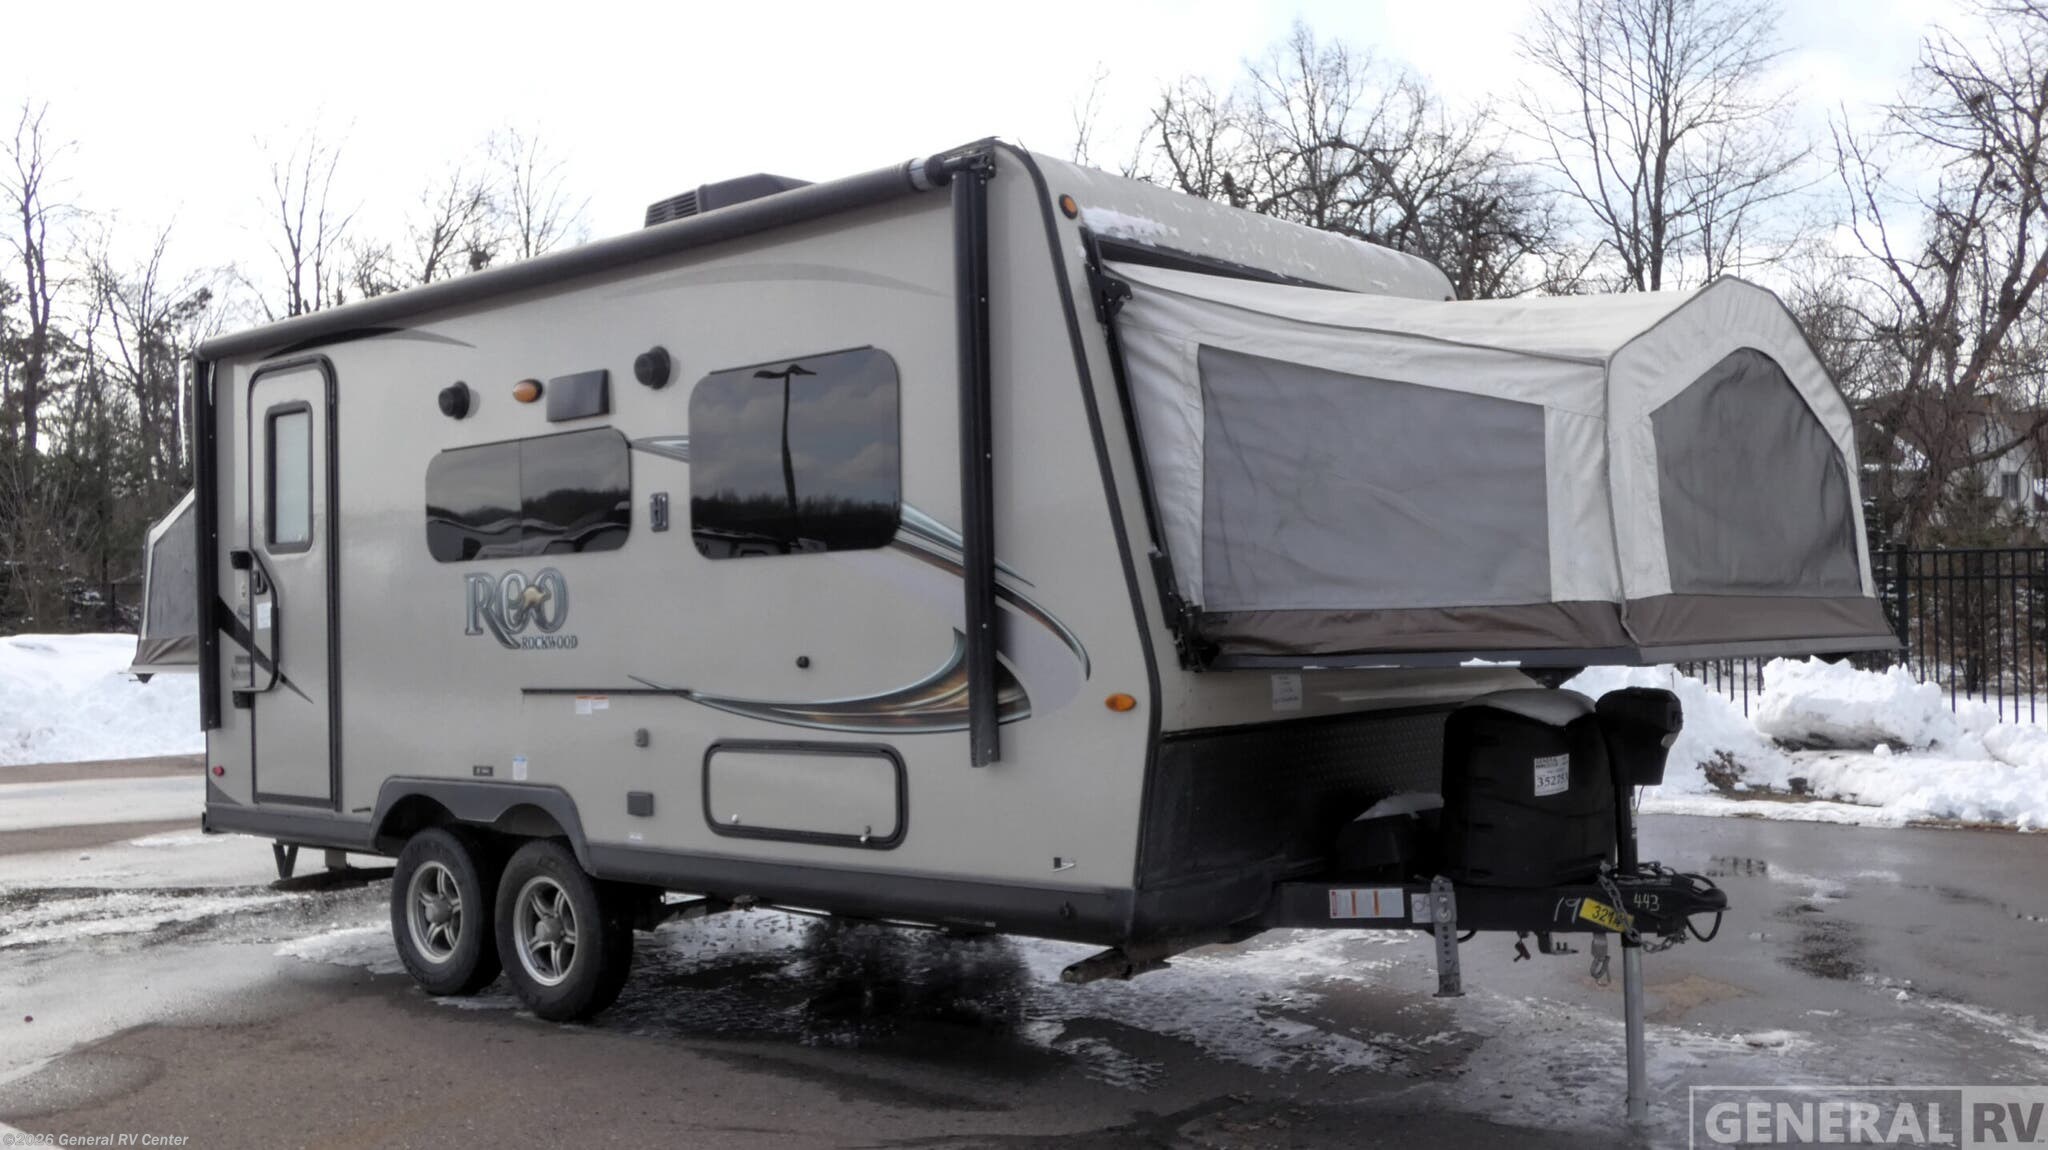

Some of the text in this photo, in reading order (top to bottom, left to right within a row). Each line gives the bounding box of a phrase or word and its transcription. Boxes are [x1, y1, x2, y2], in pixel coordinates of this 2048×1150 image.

[464, 566, 569, 650] ROO
[521, 634, 579, 650] ROCKWOOD
[1553, 895, 1582, 924] 19
[1633, 892, 1661, 912] 443
